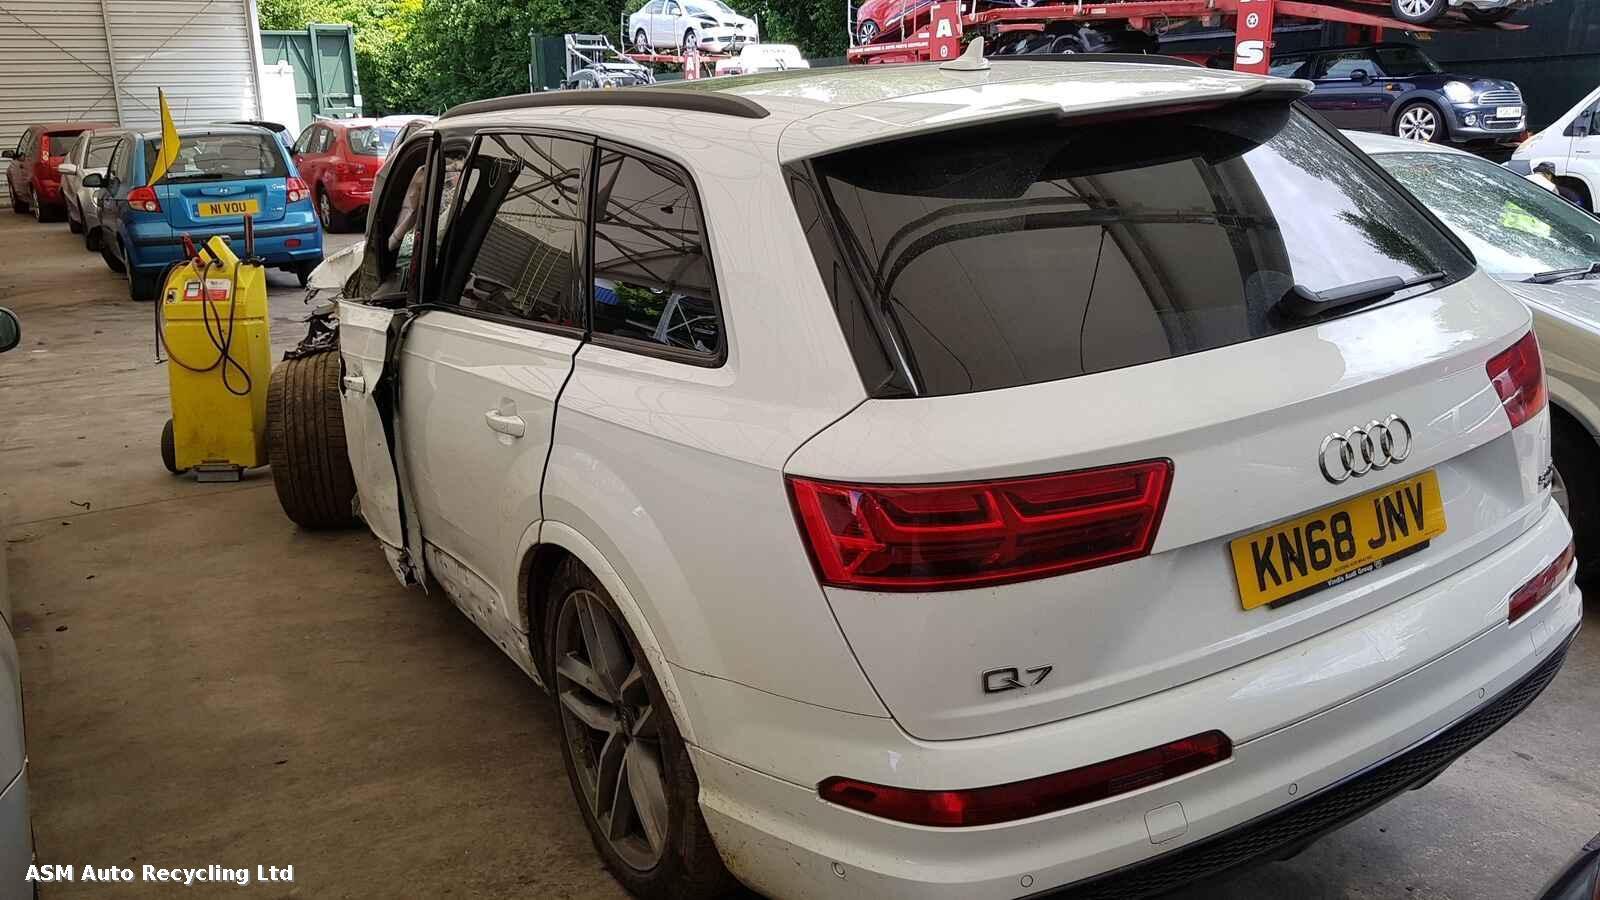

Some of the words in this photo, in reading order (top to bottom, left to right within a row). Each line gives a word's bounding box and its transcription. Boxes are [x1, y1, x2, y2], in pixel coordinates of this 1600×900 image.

[936, 19, 953, 38] A
[1236, 40, 1264, 65] S
[1251, 511, 1356, 592] KN68
[1368, 483, 1424, 549] JNV
[982, 665, 1053, 694] Q7
